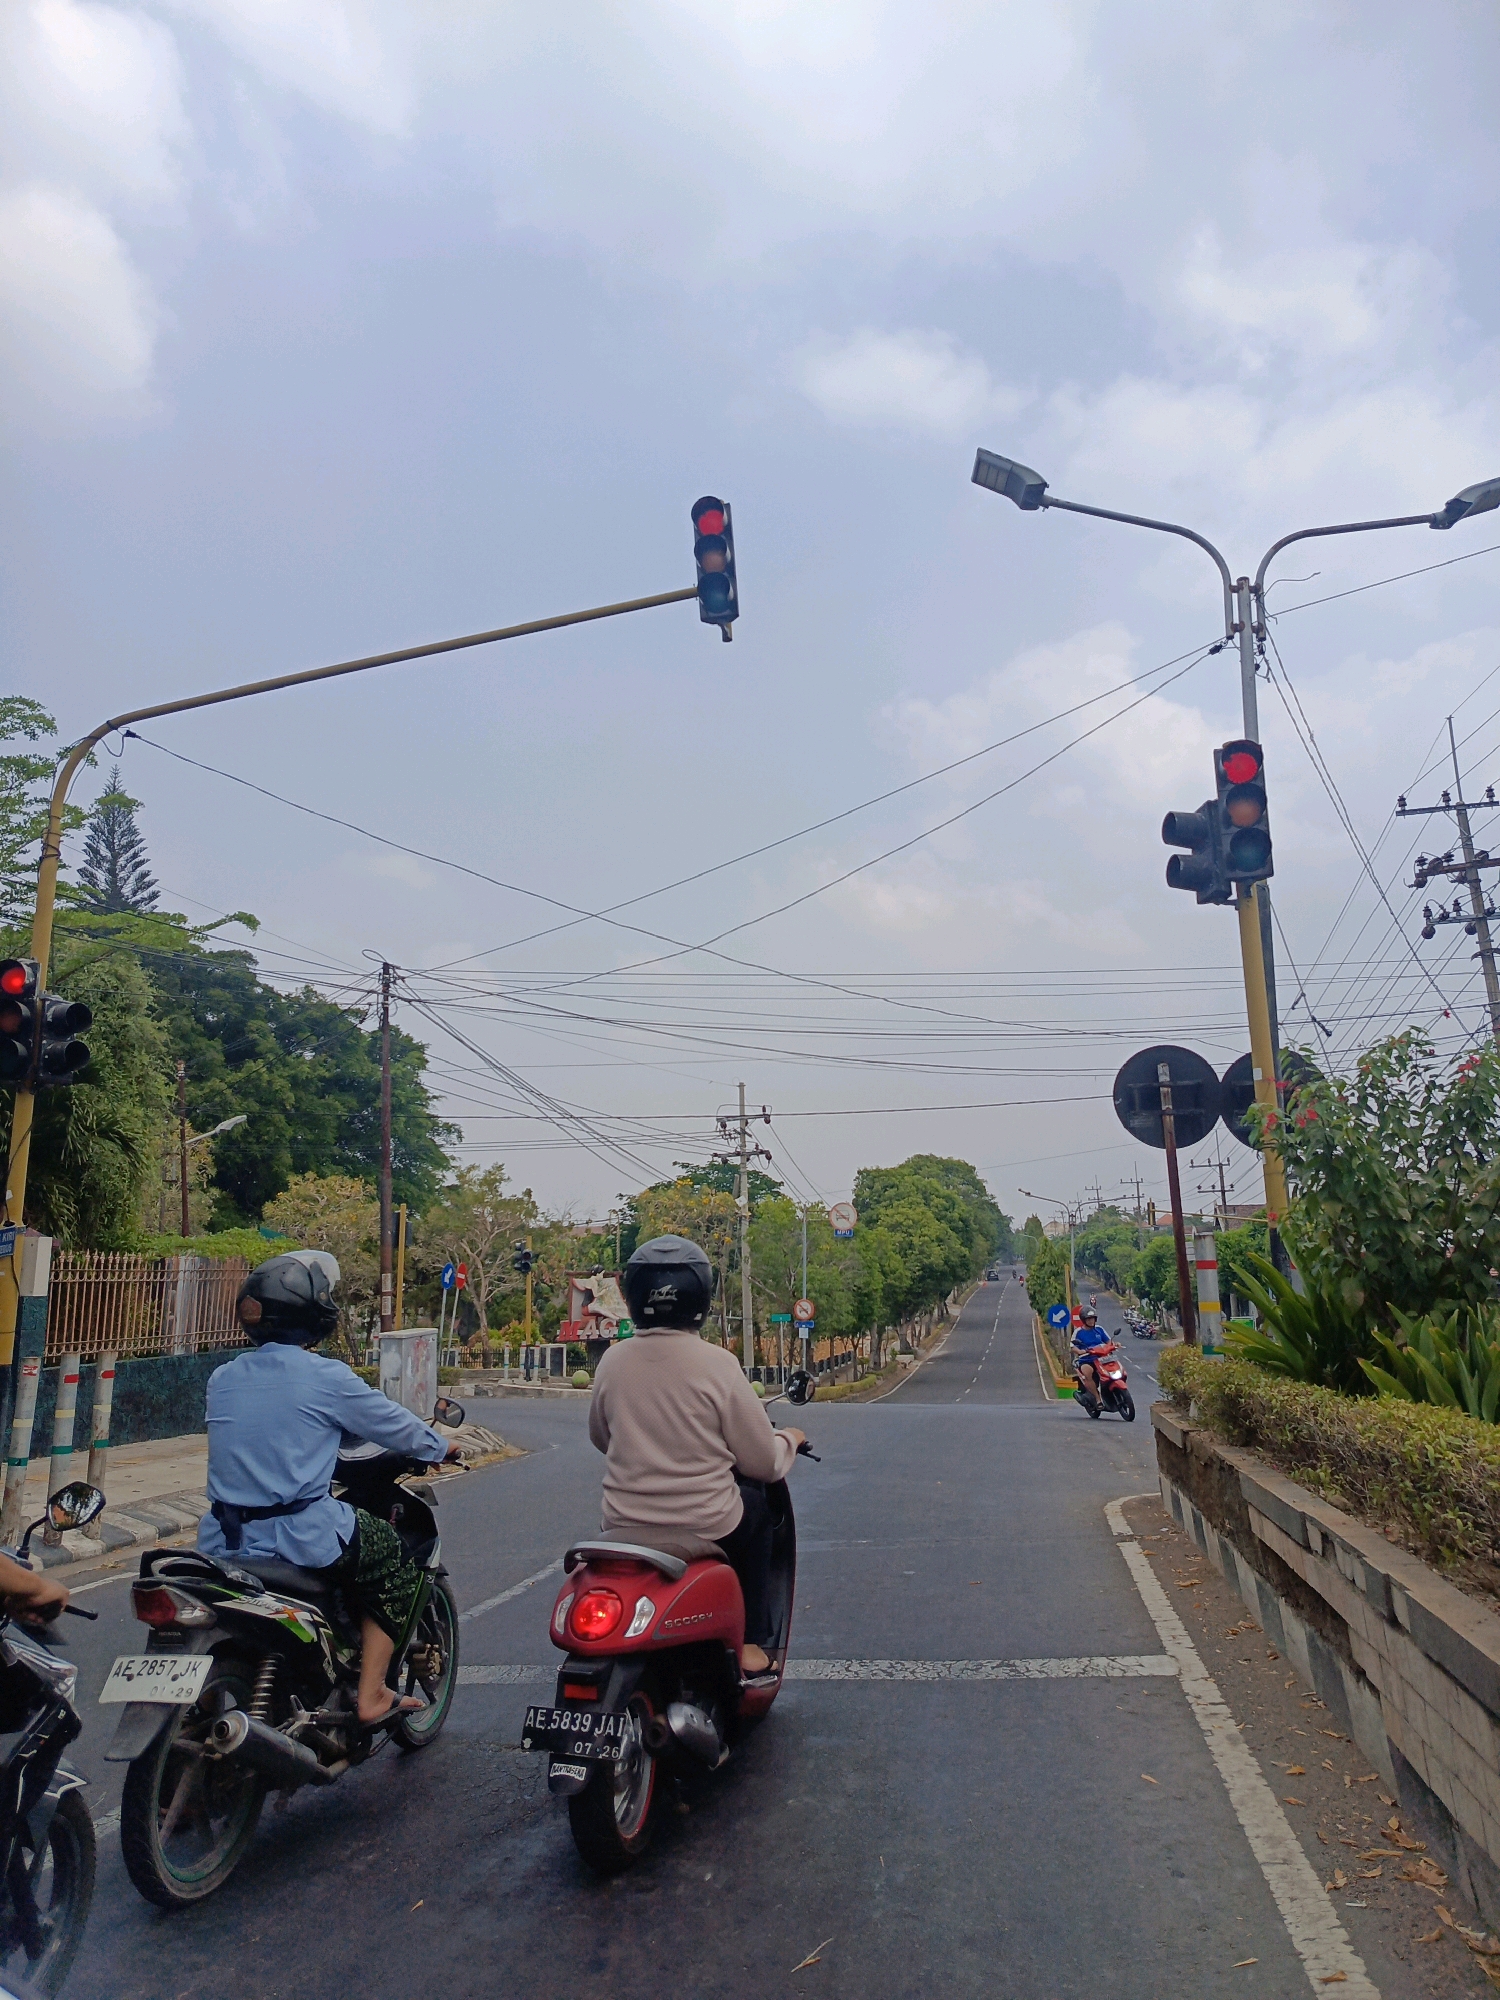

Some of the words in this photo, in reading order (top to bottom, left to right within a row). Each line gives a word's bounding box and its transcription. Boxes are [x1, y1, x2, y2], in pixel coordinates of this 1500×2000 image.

[112, 1660, 135, 1677] AE
[136, 1660, 178, 1676] 2857
[179, 1660, 203, 1677] JK
